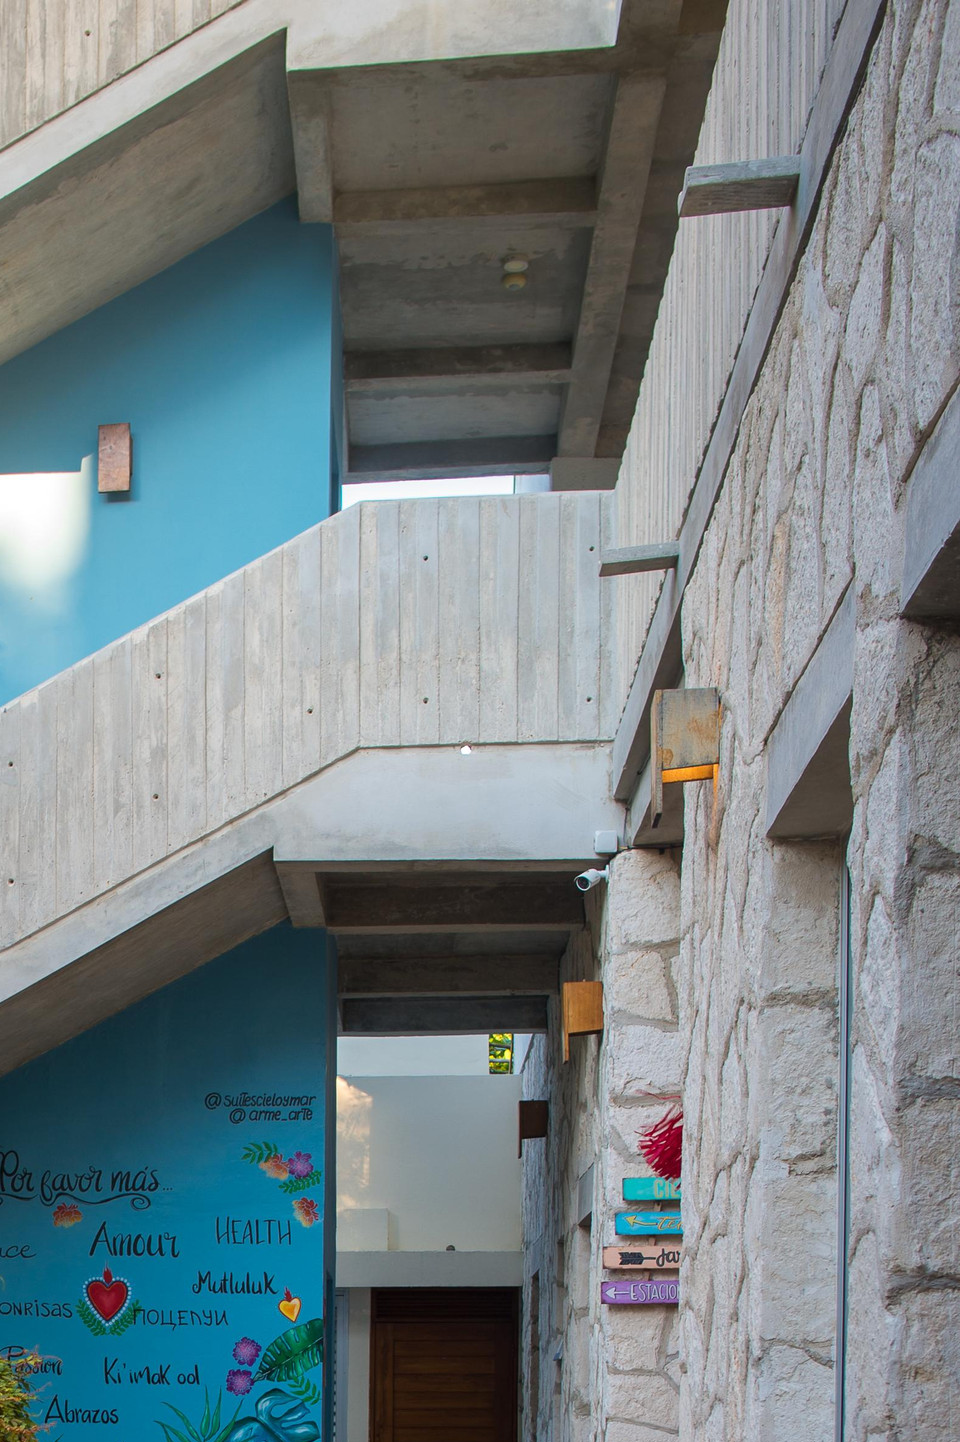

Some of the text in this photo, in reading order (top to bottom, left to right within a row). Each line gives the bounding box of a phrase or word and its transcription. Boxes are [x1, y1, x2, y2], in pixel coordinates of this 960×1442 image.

[40, 1166, 103, 1202] favor
[89, 1221, 180, 1258] Amour
[215, 1216, 292, 1245] HEALTH
[192, 1270, 279, 1295] Mutluluk
[630, 1284, 679, 1302] ESTACIO
[177, 1364, 200, 1385] ool
[44, 1395, 119, 1424] Abrazos
